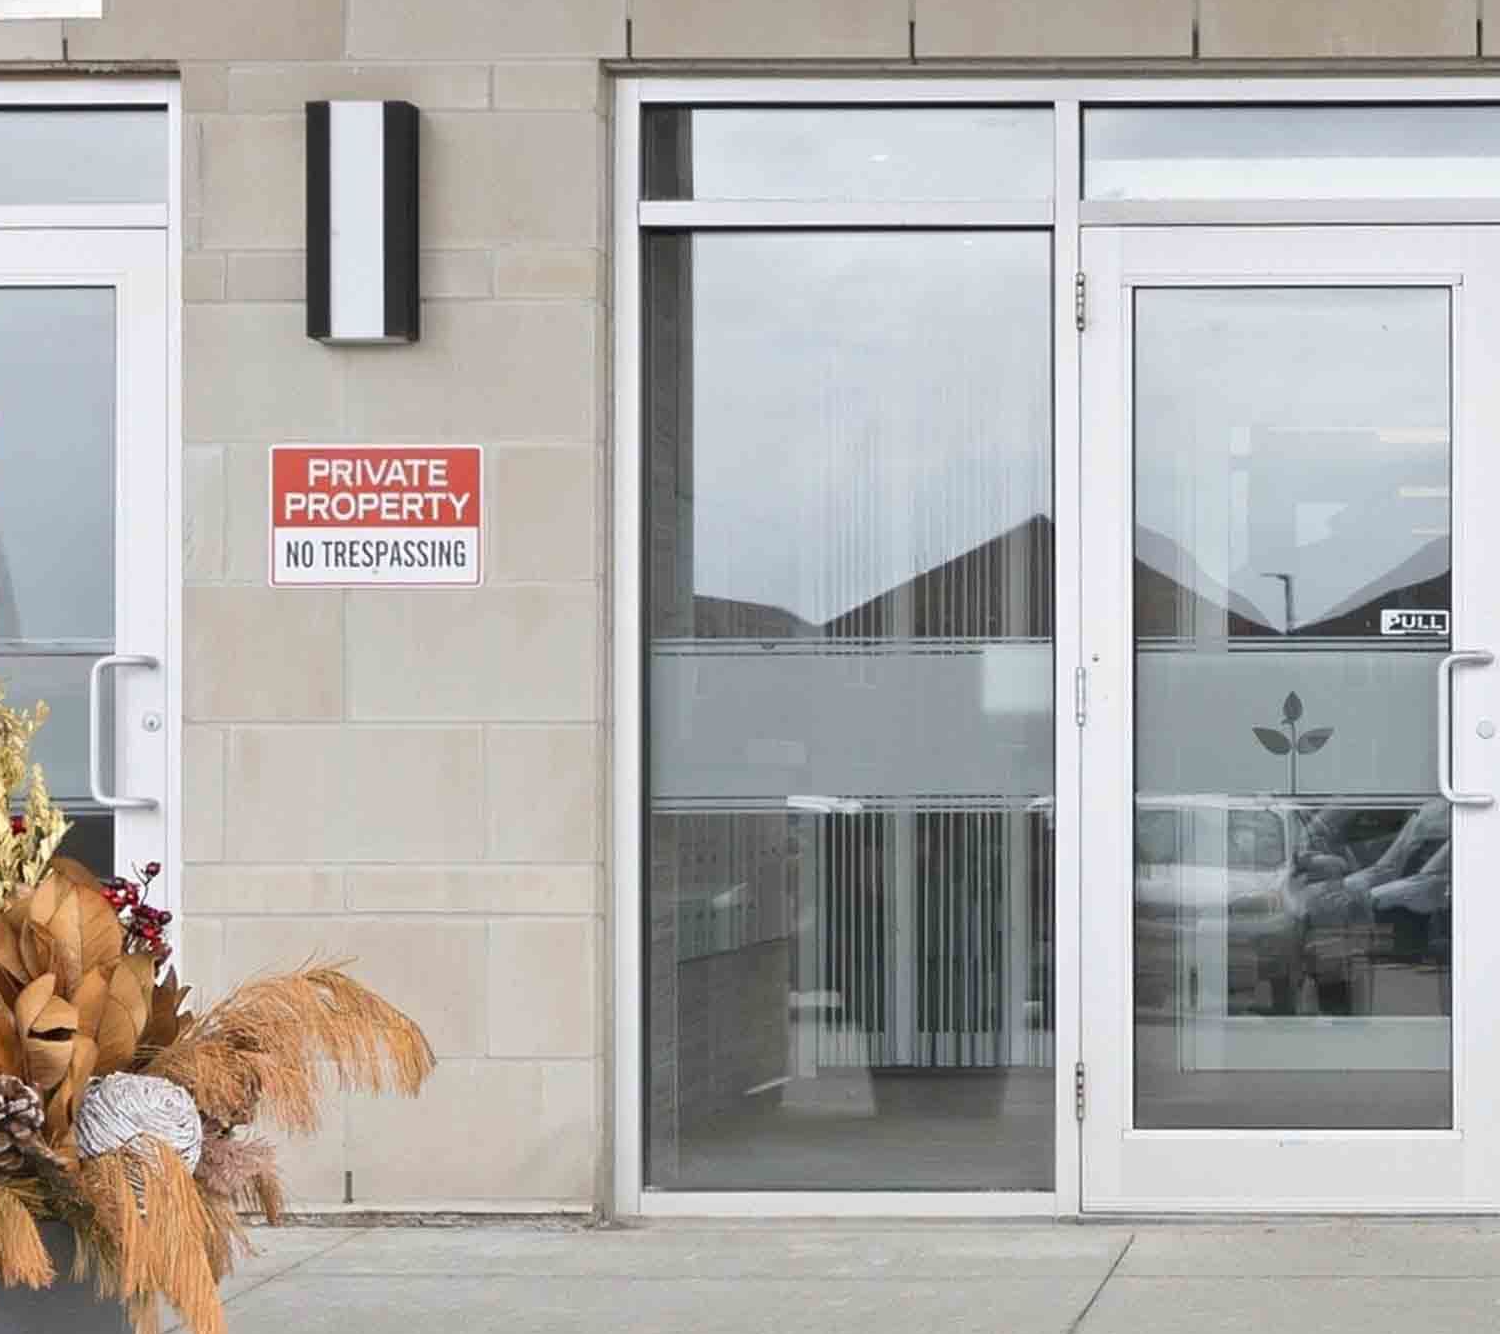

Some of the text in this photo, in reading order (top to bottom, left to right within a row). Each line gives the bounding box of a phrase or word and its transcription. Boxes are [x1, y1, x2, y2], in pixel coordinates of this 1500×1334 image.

[307, 458, 449, 487] PRIVATE
[284, 492, 471, 521] PROPERTY
[285, 540, 467, 568] NO TRESPASSING
[1387, 614, 1443, 630] PULL
